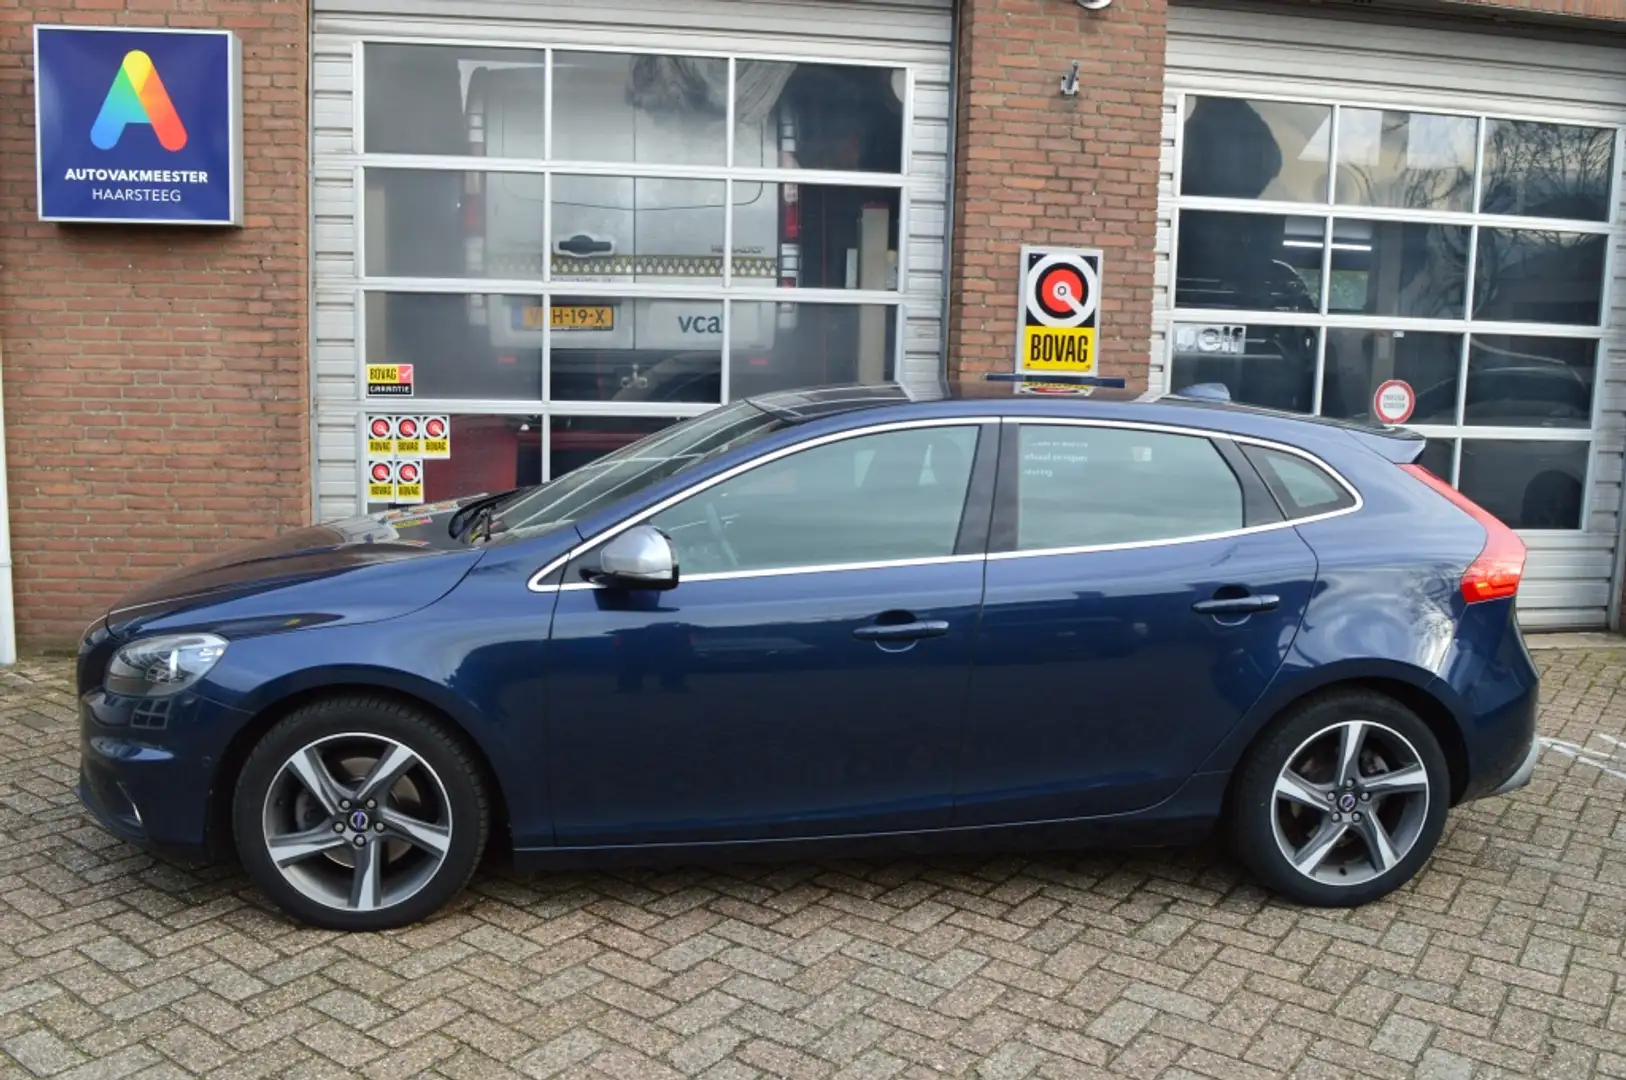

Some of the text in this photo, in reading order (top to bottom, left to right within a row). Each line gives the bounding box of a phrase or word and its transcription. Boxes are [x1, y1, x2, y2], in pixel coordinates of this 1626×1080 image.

[64, 168, 208, 184] AUTOVAKMEESTER
[91, 188, 182, 202] HAARSTEEG
[529, 307, 605, 325] VH-19-X
[1030, 333, 1089, 364] BOVAG
[369, 367, 397, 381] BOVAG
[369, 385, 411, 394] GARANTIE
